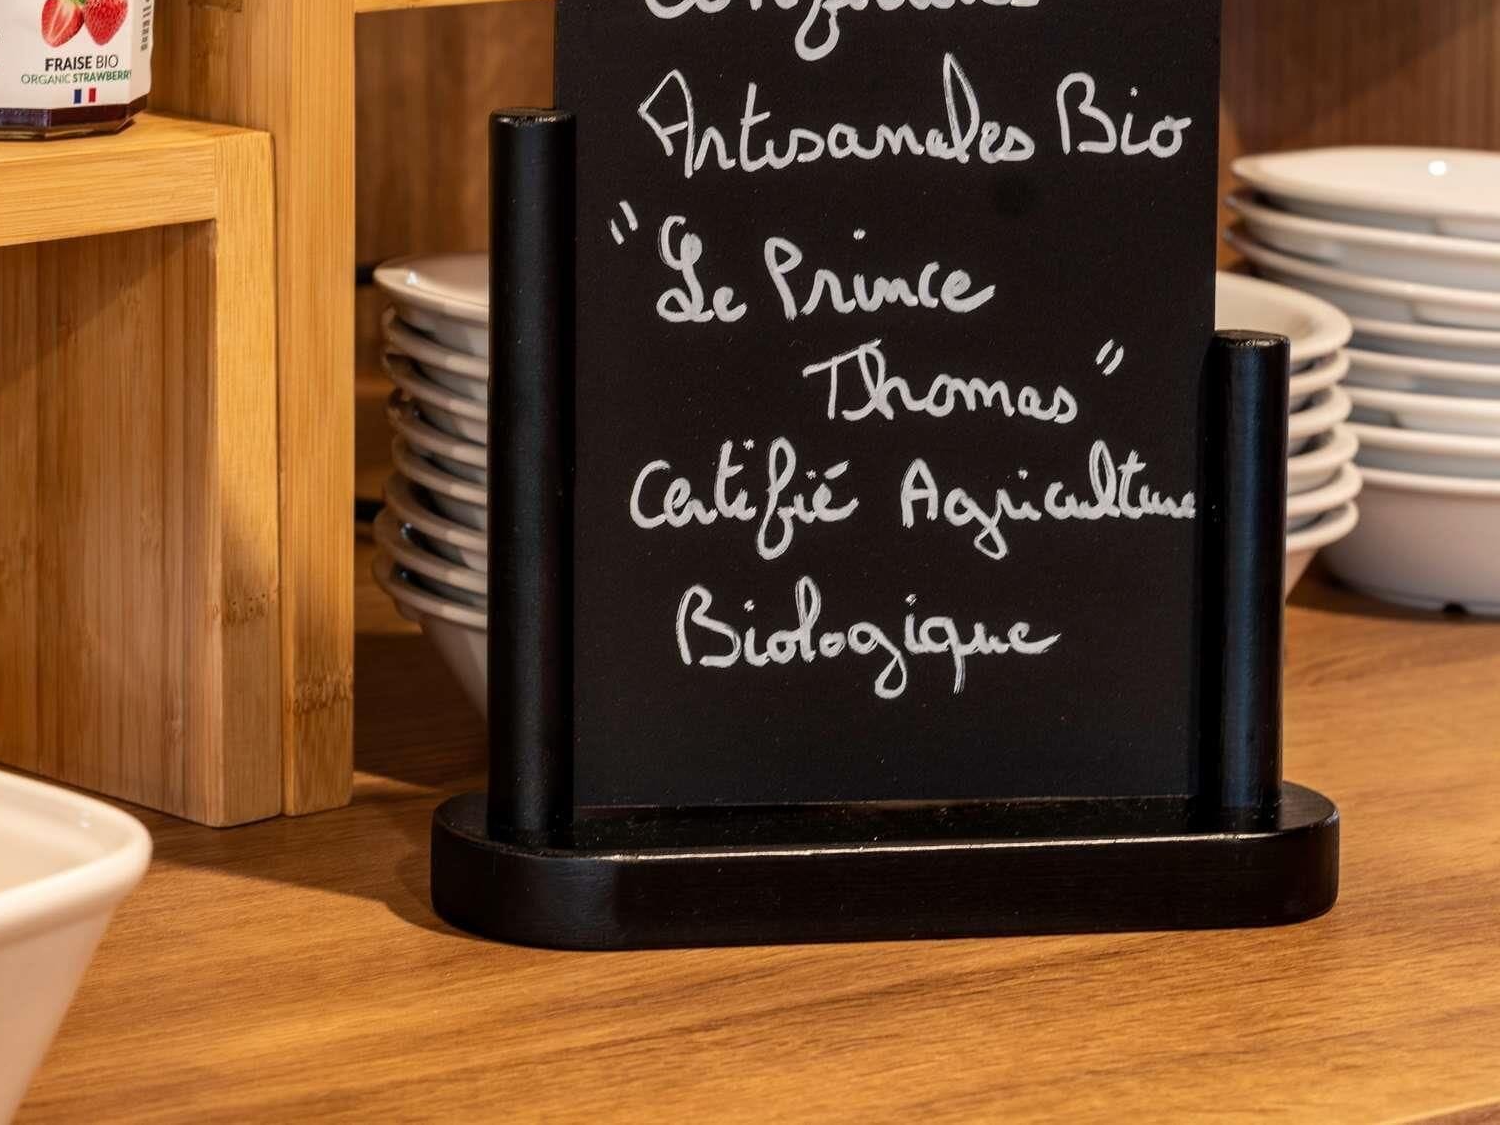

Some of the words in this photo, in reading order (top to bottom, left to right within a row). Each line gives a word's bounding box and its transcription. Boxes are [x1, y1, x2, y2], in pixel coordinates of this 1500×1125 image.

[20, 74, 71, 85] ORGANIC
[44, 55, 93, 72] FRAISE
[95, 54, 119, 69] BIO
[637, 52, 1036, 179] Artisanales
[1056, 71, 1193, 159] Bio
[763, 227, 996, 321] Prince
[629, 436, 860, 561] Certifié
[900, 439, 1198, 561] Agriculture
[675, 574, 1062, 699] Biologique
